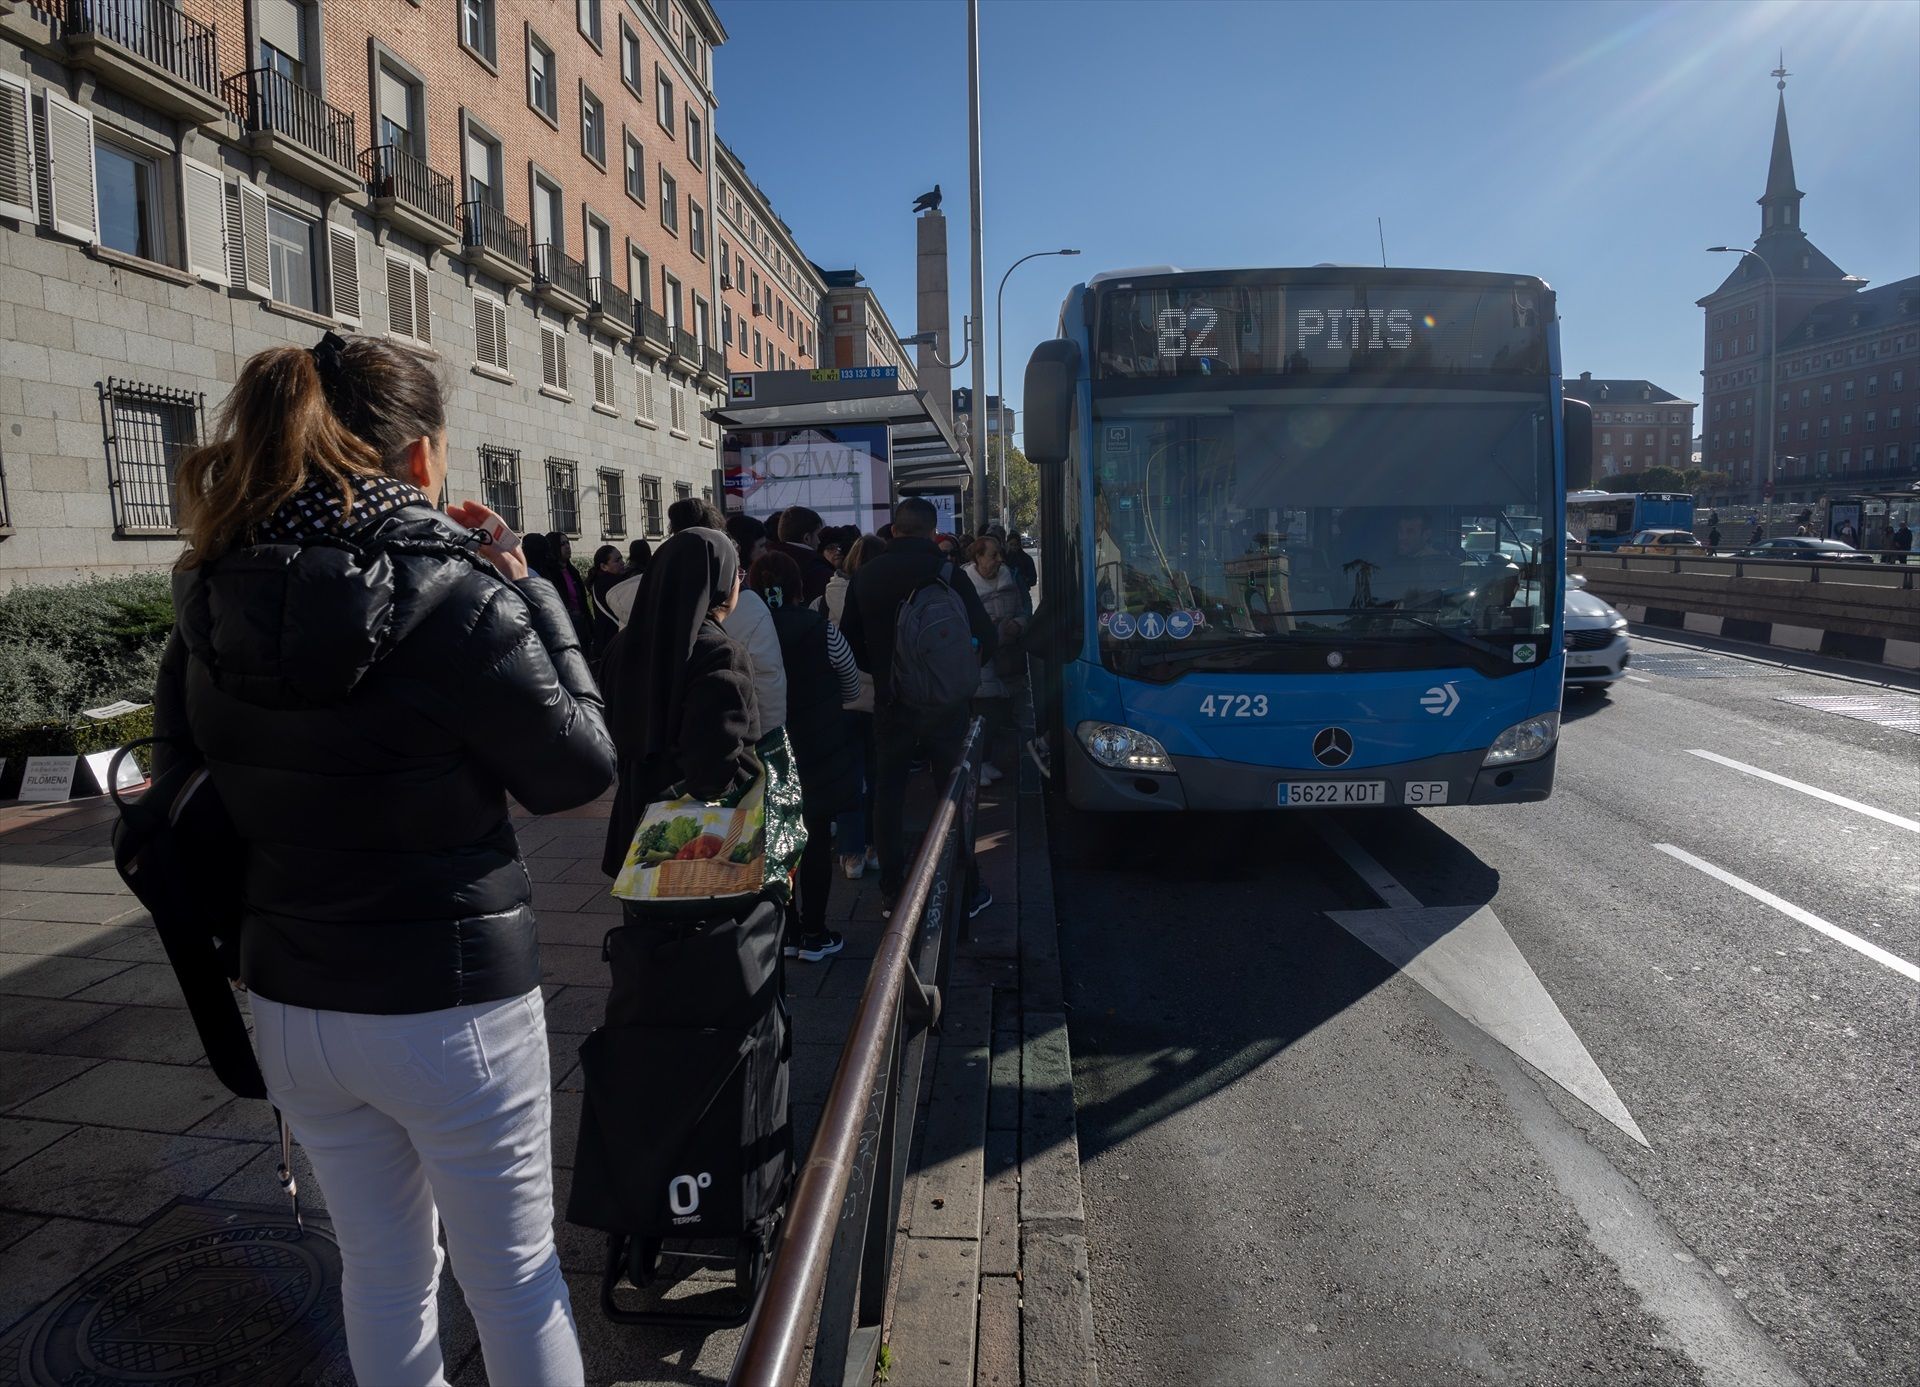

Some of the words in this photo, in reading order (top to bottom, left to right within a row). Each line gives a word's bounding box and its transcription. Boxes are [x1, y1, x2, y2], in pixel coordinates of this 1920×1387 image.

[1157, 307, 1219, 357] 82
[1298, 308, 1413, 350] PITIS
[841, 369, 853, 379] 133
[855, 369, 868, 378] 132
[870, 368, 881, 378] 83
[885, 367, 896, 377] 82
[1517, 649, 1532, 658] GNC
[1199, 694, 1269, 718] 4723
[27, 775, 68, 785] FILOMENA
[1290, 785, 1338, 803] 5622
[1344, 783, 1379, 802] KDT
[671, 1214, 702, 1226] TERMIC
